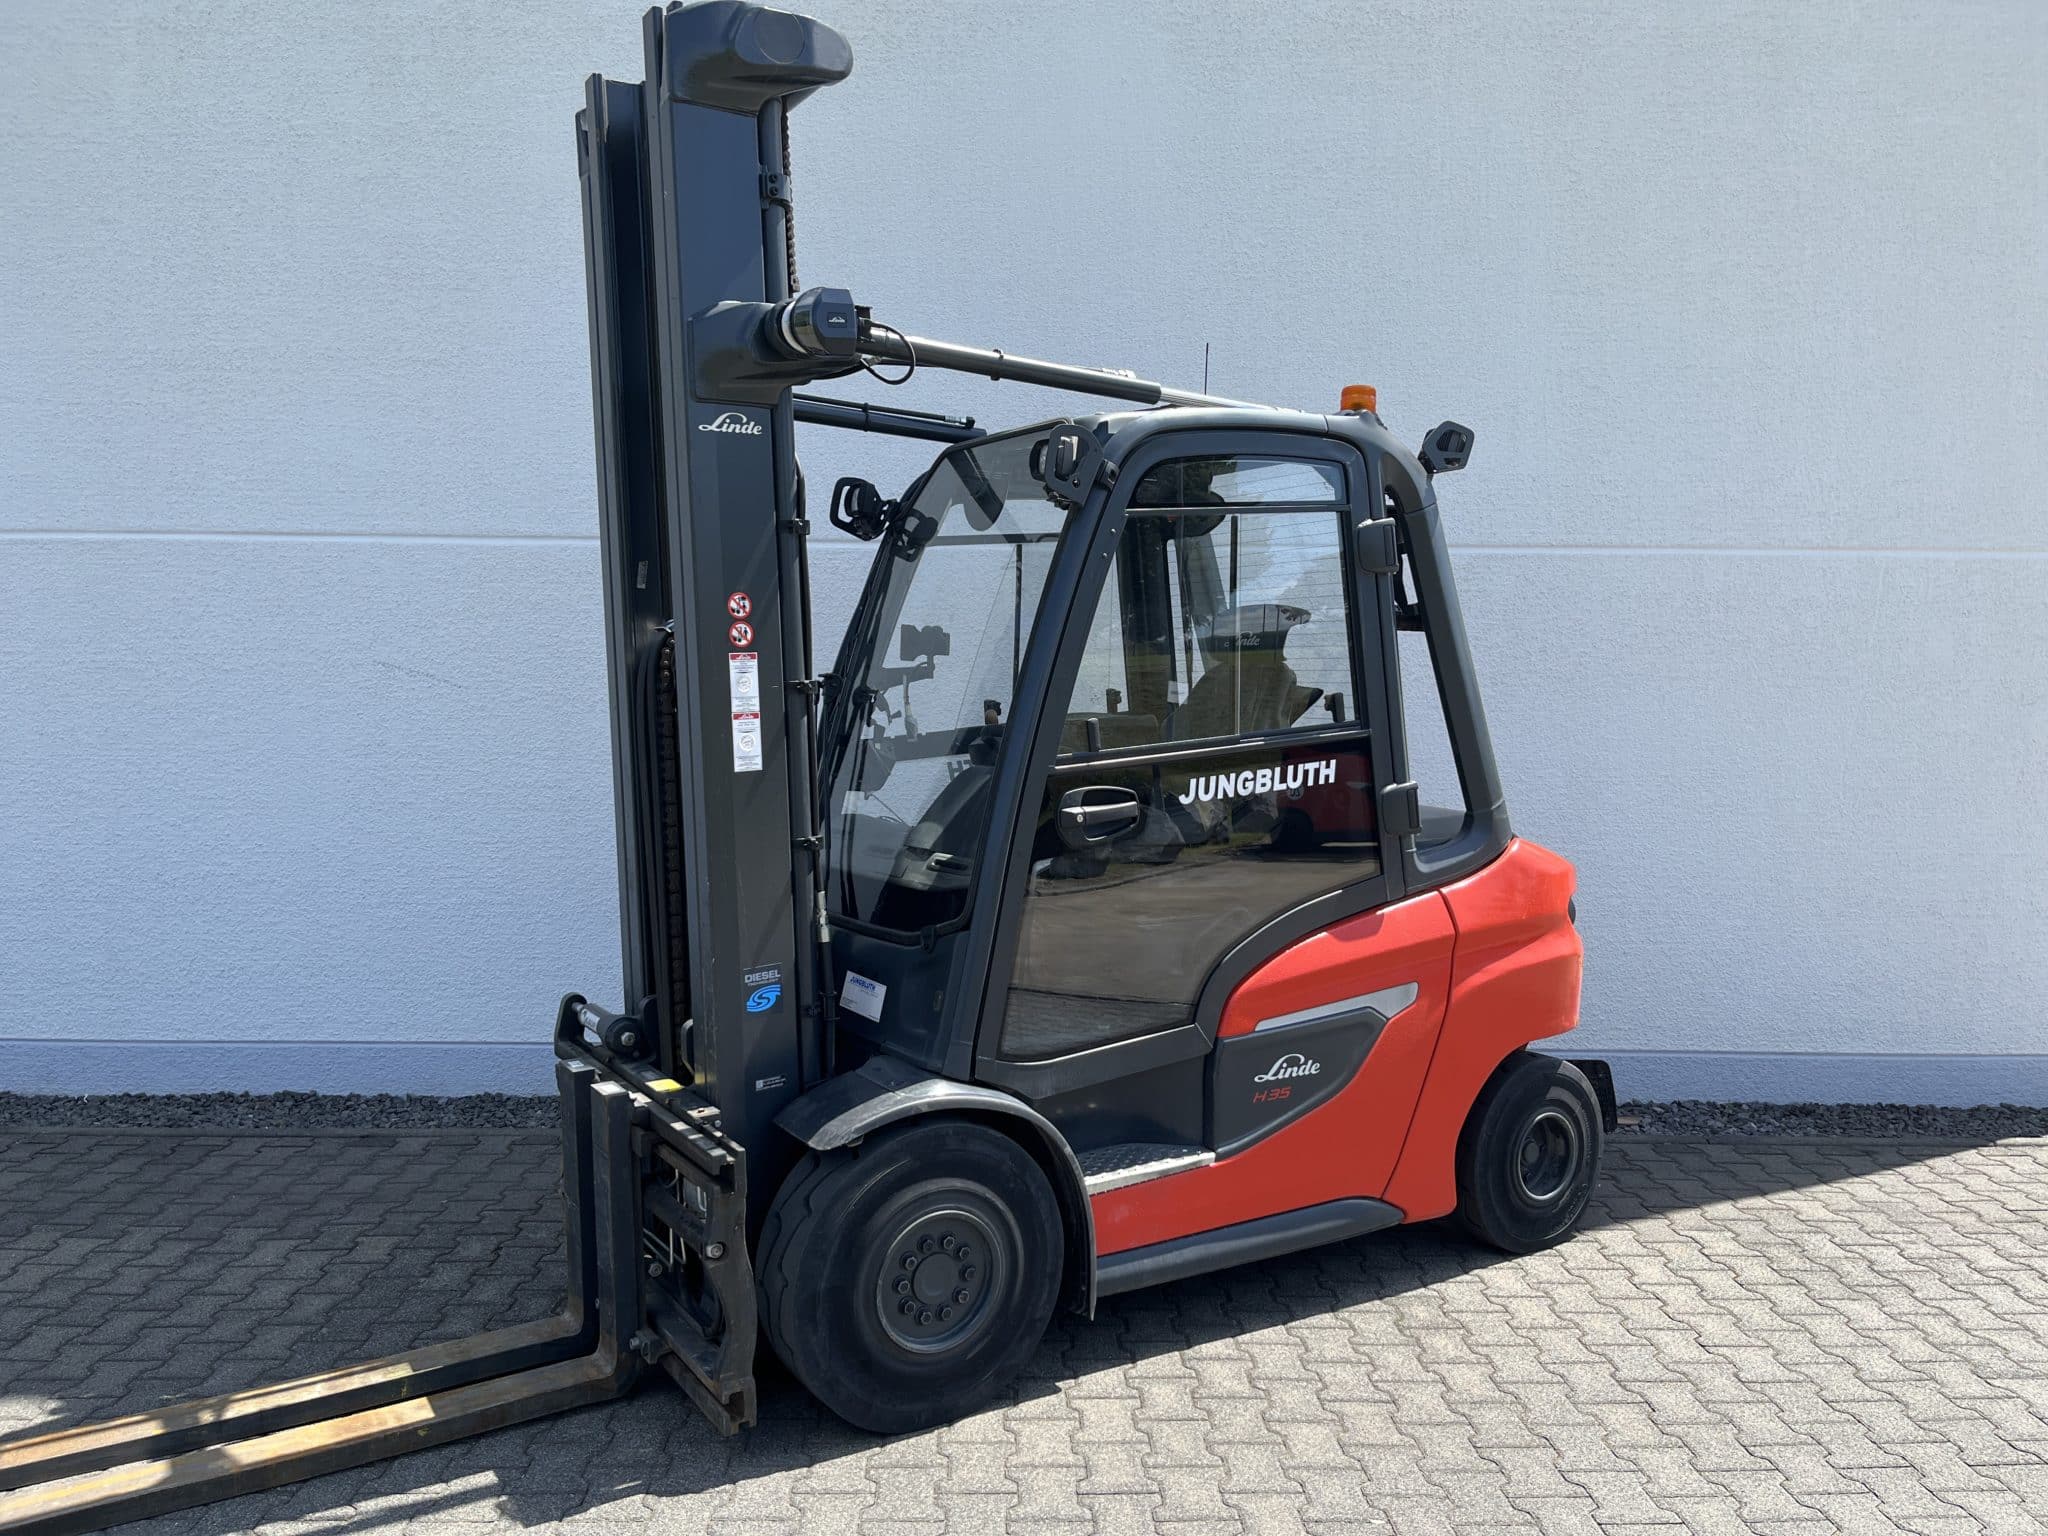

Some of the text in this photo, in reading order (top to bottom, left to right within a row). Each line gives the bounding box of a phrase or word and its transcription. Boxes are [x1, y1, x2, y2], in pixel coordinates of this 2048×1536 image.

[698, 412, 763, 435] Linde
[1178, 759, 1337, 805] JUNGBLUTH
[744, 969, 781, 983] DIESEL
[1254, 1053, 1321, 1083] Linde
